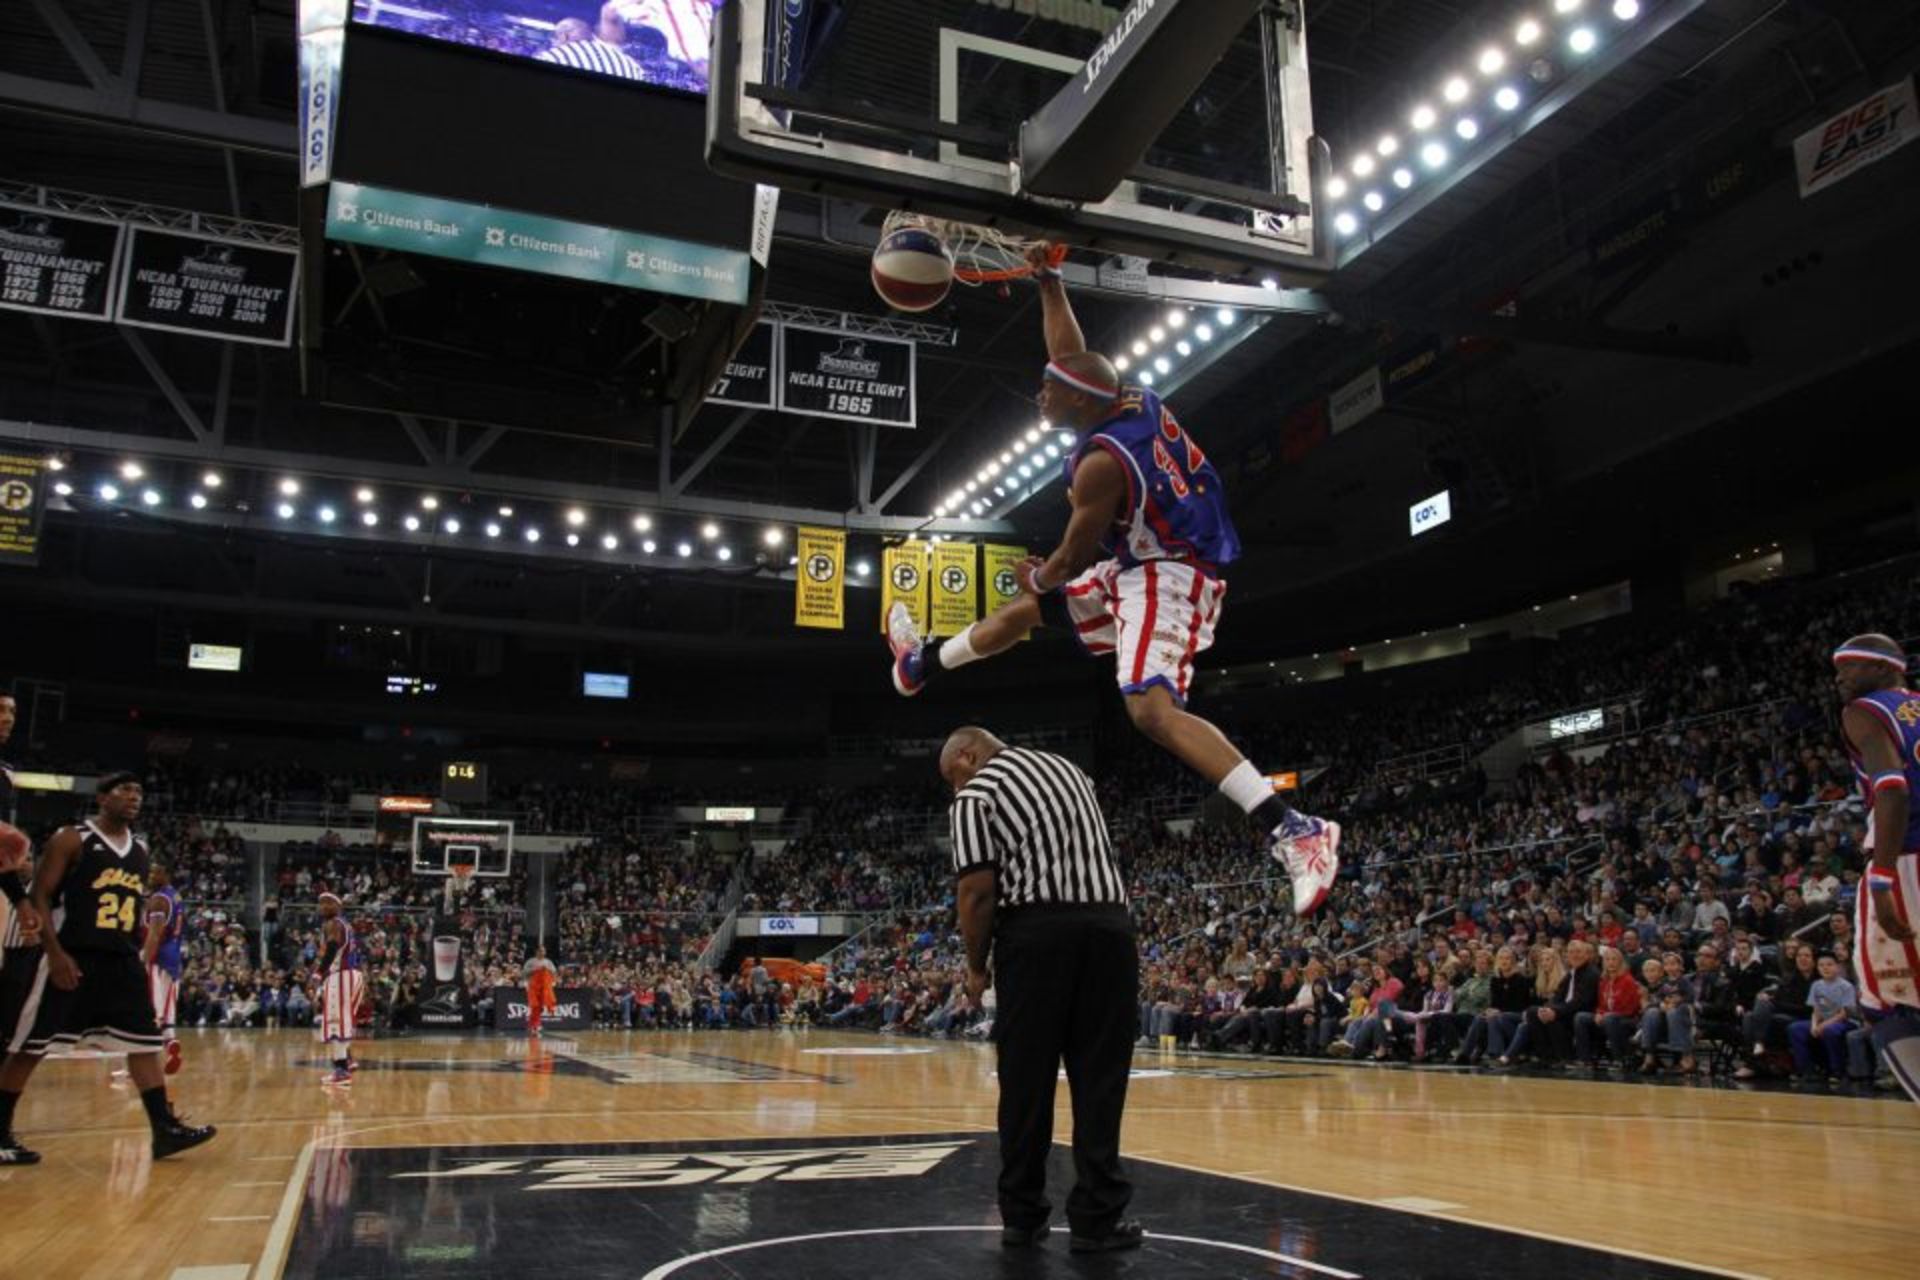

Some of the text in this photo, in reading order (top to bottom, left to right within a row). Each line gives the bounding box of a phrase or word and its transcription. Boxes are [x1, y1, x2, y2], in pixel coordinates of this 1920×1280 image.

[1083, 0, 1155, 93] SPALDIN
[1822, 96, 1888, 148] BIG
[309, 129, 324, 171] COX
[1814, 103, 1905, 171] EAST
[363, 208, 460, 237] Citizens Bank
[509, 232, 602, 260] Citizens Bank
[0, 247, 104, 276] OURNAMENT
[649, 256, 736, 283] Citizens Bank
[136, 268, 285, 302] NCAA TOURNAMENT
[188, 303, 225, 318] 2001
[724, 362, 767, 379] EIGHT
[788, 371, 908, 399] NCAA ELITE EIGHT
[827, 393, 873, 415] 1965
[1415, 505, 1438, 524] COX
[96, 892, 136, 932] 24
[768, 919, 796, 931] COX
